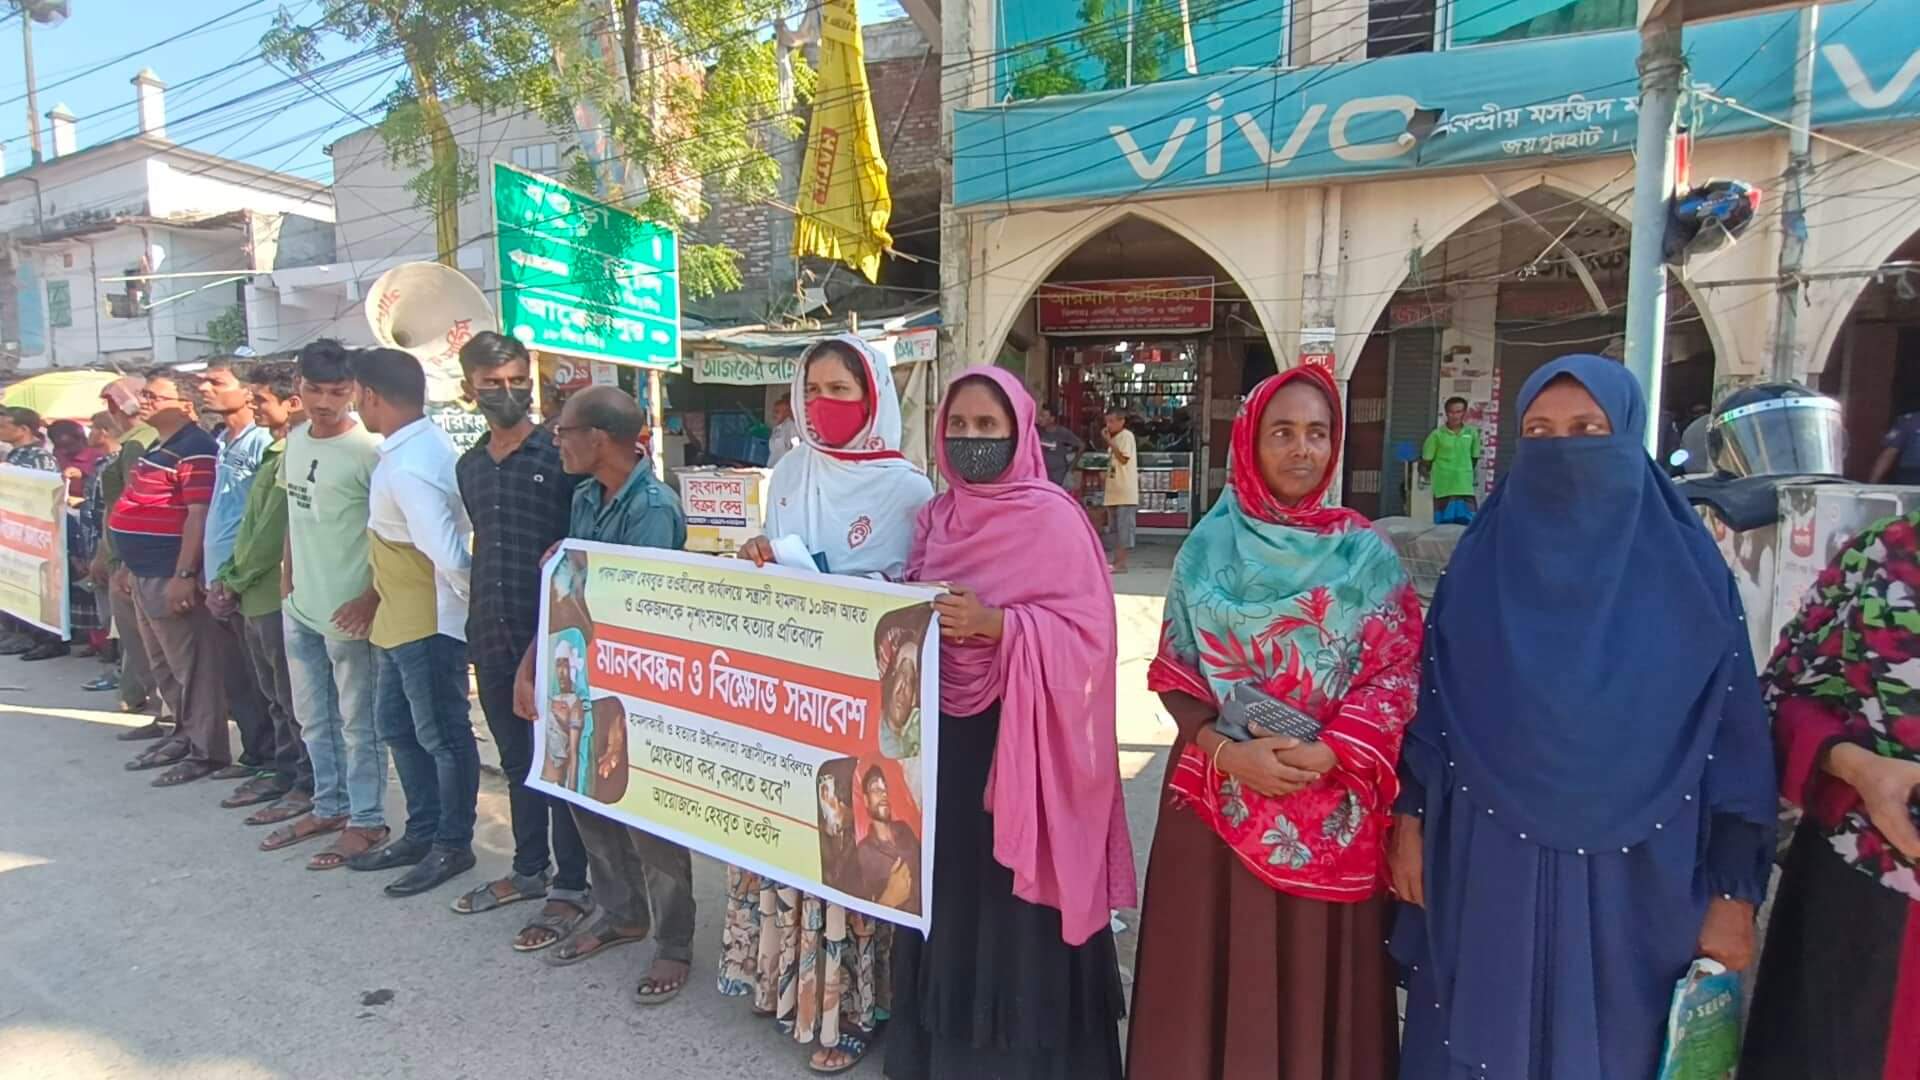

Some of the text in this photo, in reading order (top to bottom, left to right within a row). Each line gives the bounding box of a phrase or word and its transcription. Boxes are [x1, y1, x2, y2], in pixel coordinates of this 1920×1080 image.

[1525, 93, 1617, 124] মসজিদ
[1502, 125, 1605, 154] জয়পুরহাট
[702, 357, 764, 381] আজকের
[688, 480, 742, 497] সংবাদপত্র
[720, 500, 743, 515] কেন্দ্র
[625, 597, 825, 651] ও একজনকে নৃশংসভাবে হত্যার প্রতিবাদে
[839, 604, 869, 624] আহত
[596, 638, 868, 740] মানববন্ধন ও বিক্ষোভ সমাবেশ
[704, 804, 740, 835] হেযবুত
[743, 816, 782, 849] তওহীদ
